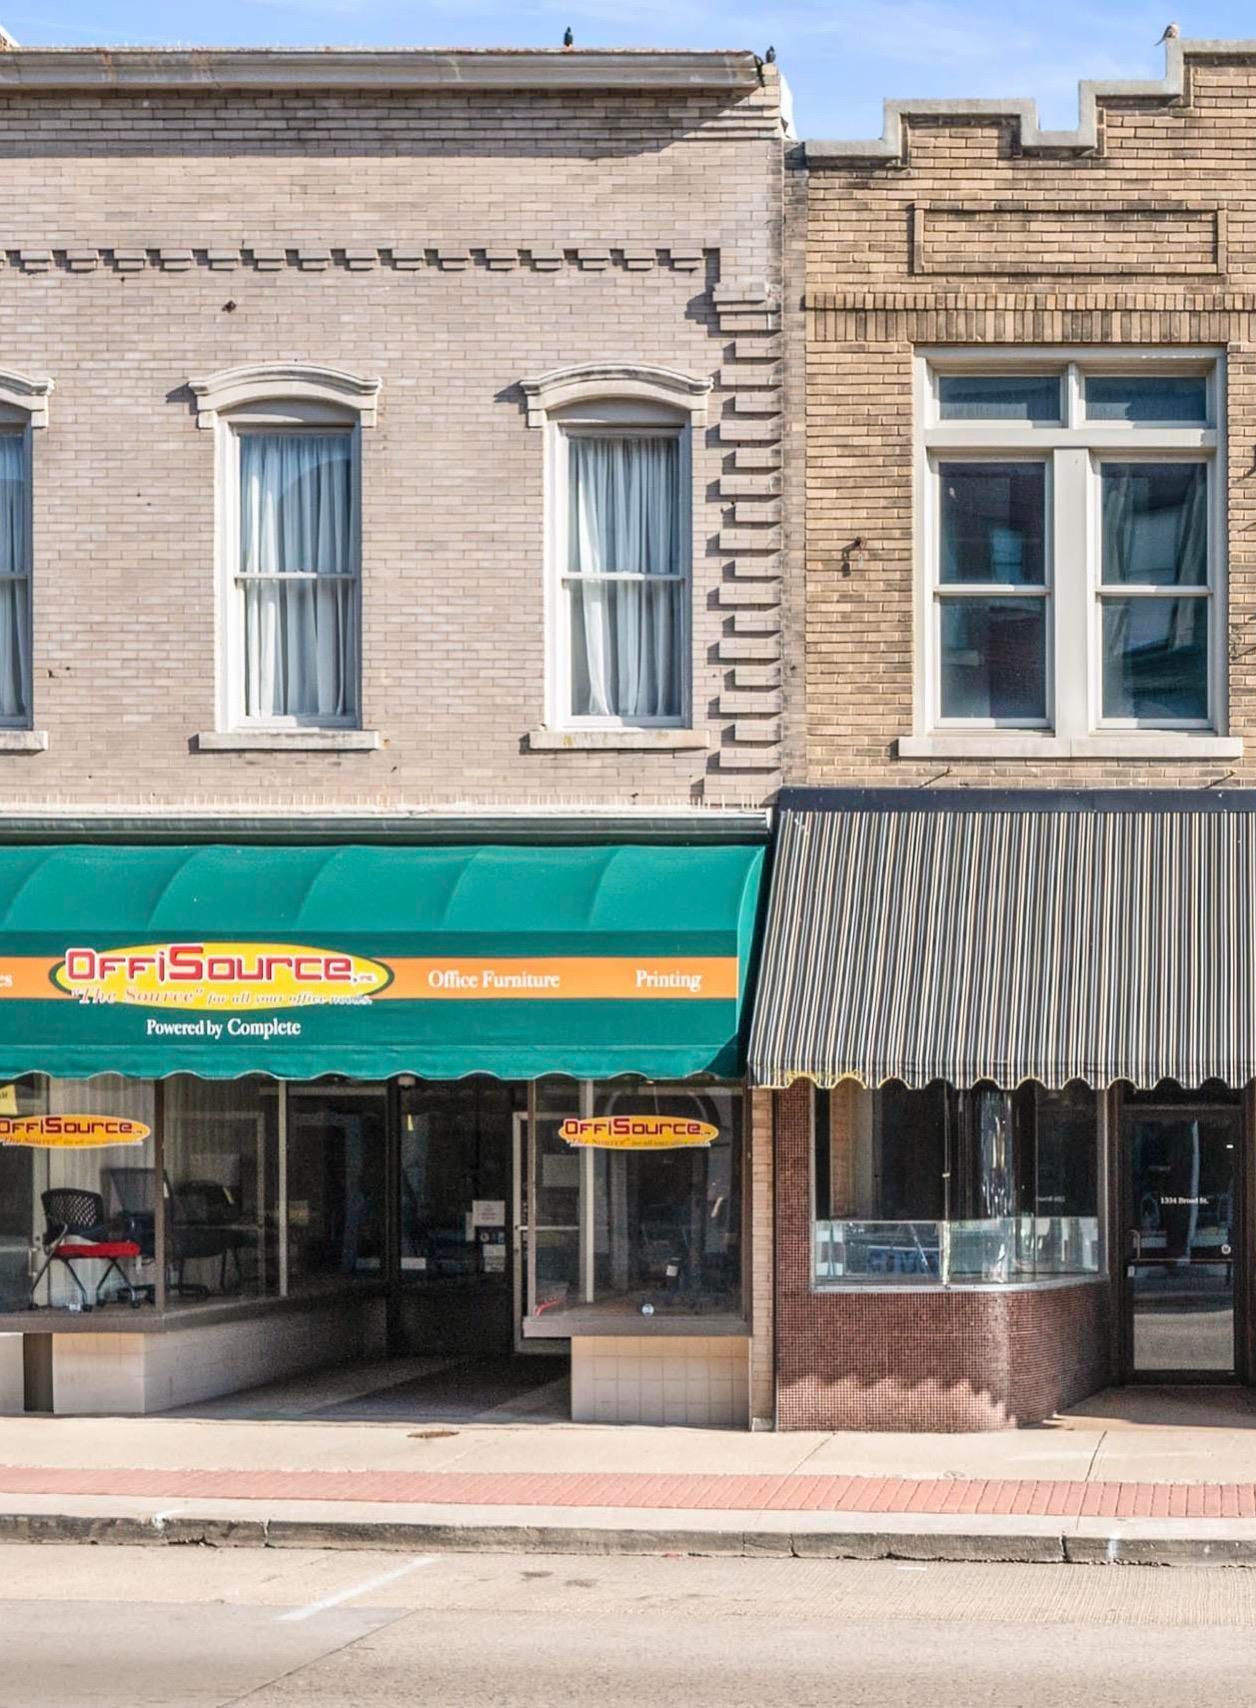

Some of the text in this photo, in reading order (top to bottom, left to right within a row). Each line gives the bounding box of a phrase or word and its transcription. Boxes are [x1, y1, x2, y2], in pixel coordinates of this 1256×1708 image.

[428, 969, 560, 988] Office Furniture
[635, 969, 703, 992] Printing
[146, 1017, 302, 1040] Powered by Complete
